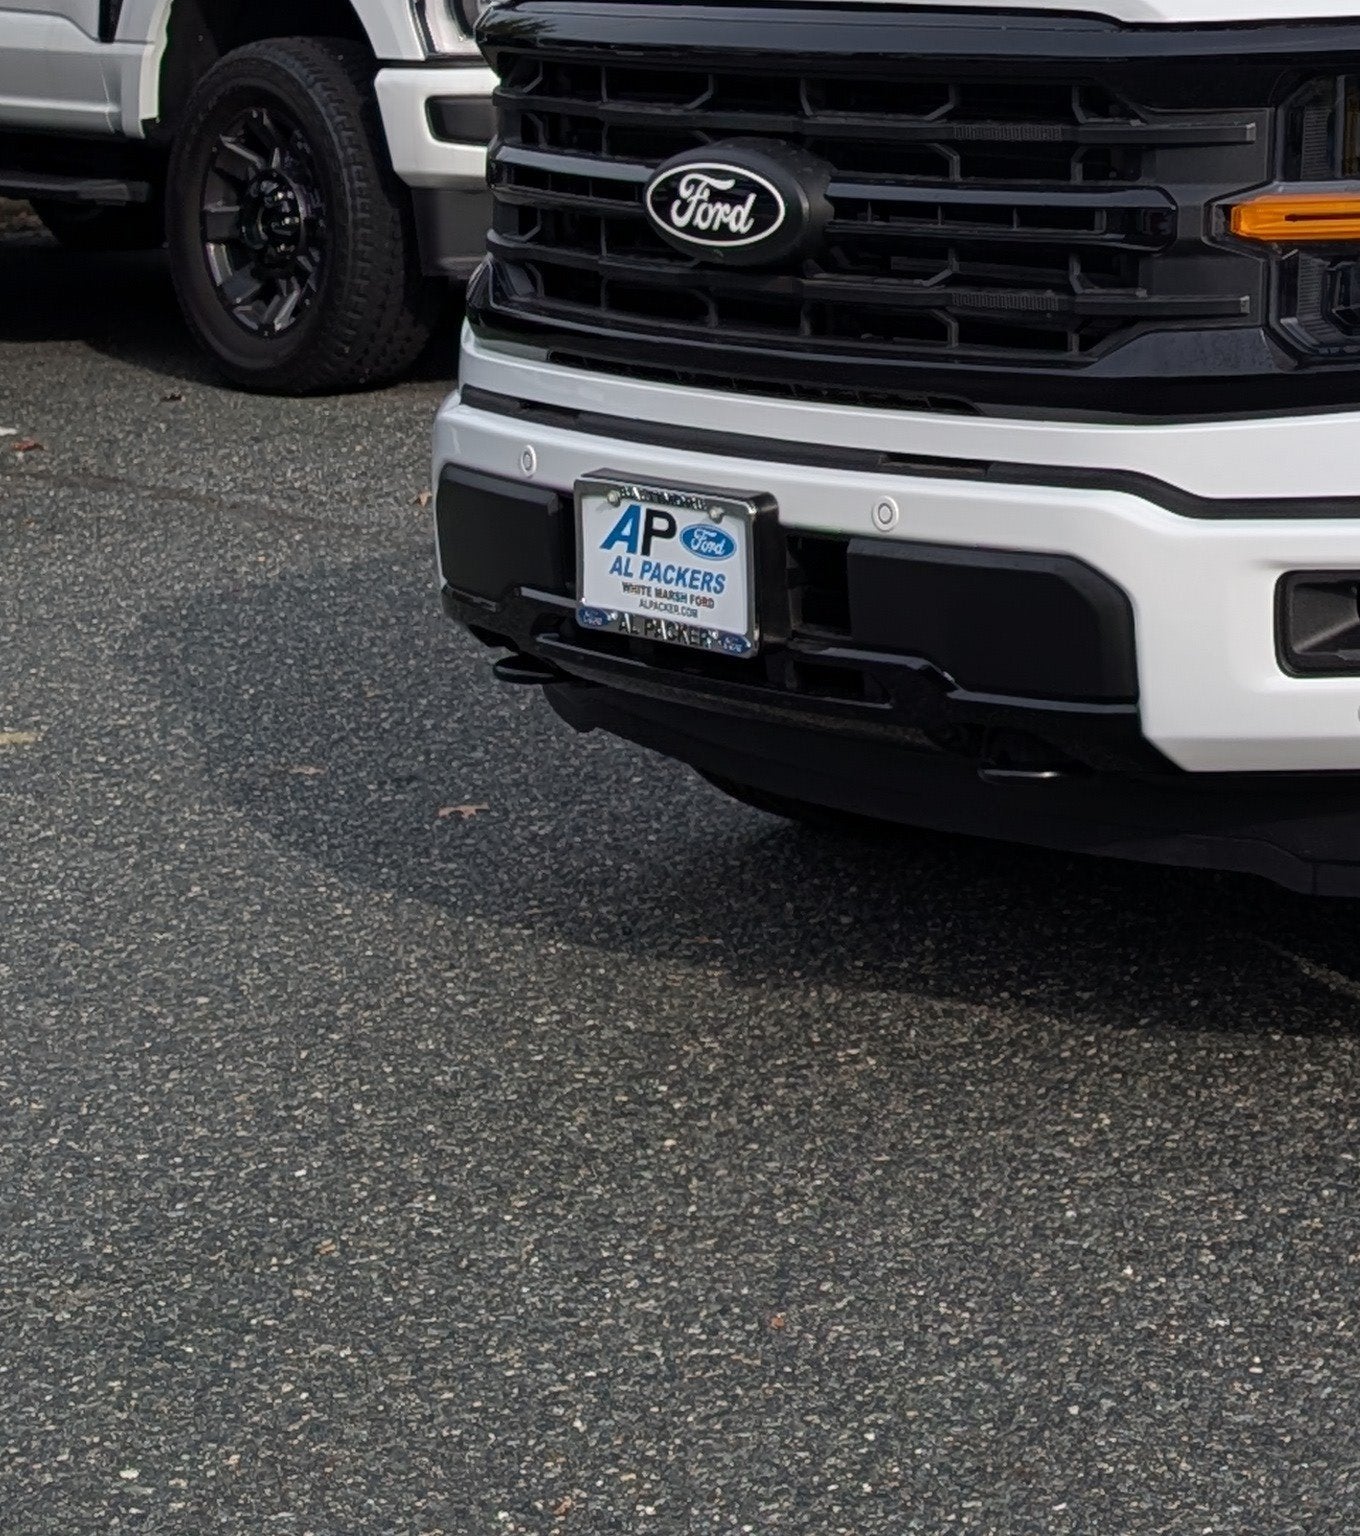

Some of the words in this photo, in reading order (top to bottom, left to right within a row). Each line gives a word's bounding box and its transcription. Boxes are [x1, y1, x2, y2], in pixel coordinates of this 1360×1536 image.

[671, 173, 757, 234] Ford
[599, 503, 677, 557] AP
[690, 528, 726, 556] Ford
[609, 555, 634, 578] AL
[640, 561, 726, 596] PACKERS
[621, 582, 652, 598] WHITE
[655, 586, 688, 604] MARSH
[690, 593, 715, 610] FORD
[638, 598, 699, 618] ALPACKER.COM
